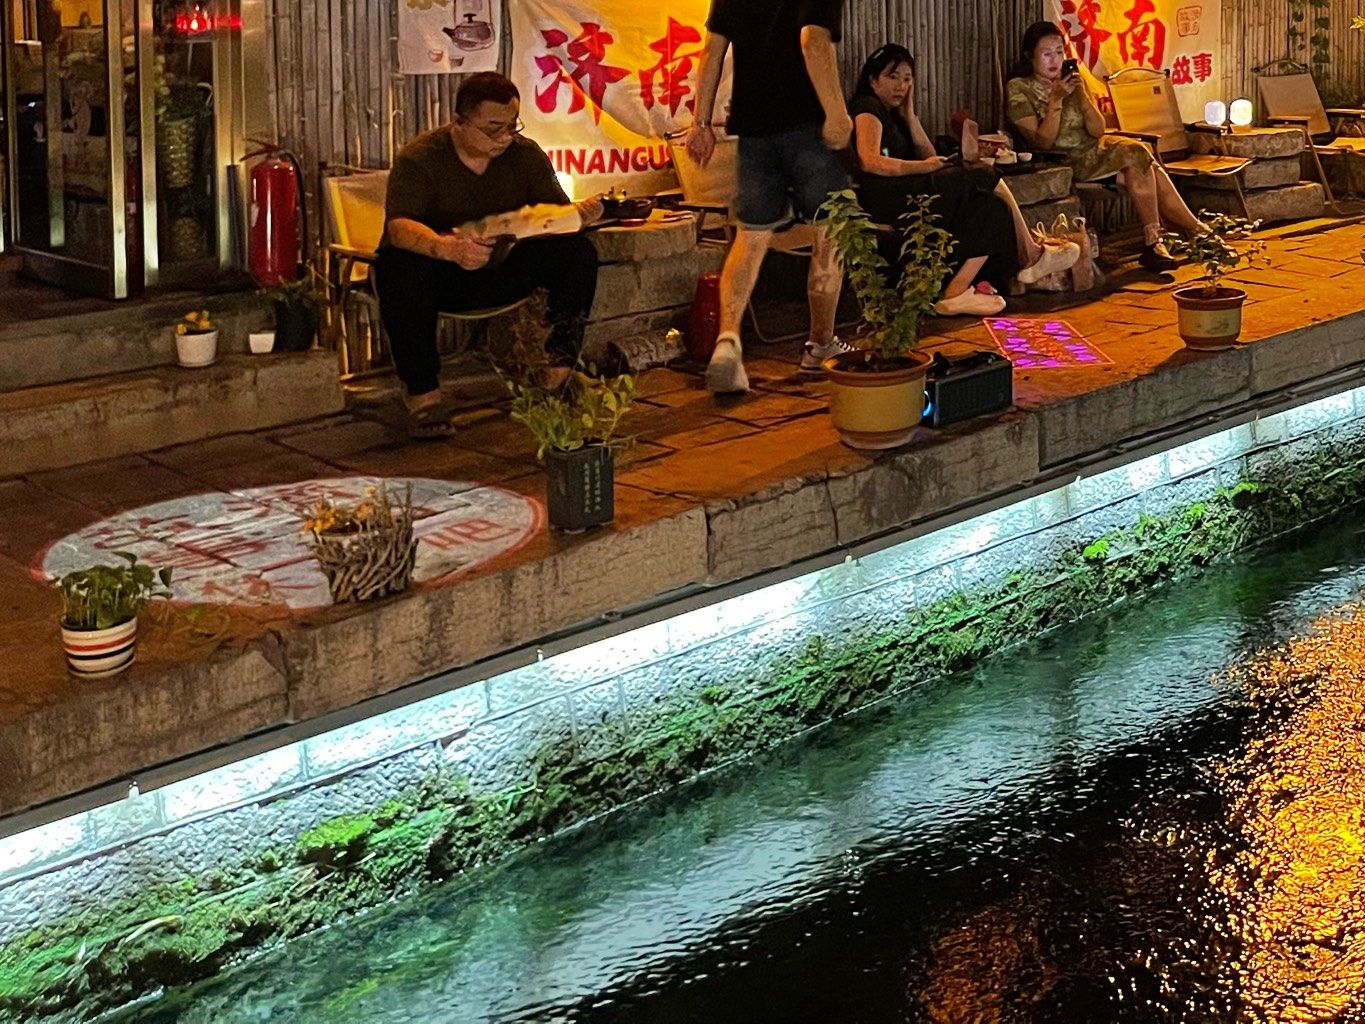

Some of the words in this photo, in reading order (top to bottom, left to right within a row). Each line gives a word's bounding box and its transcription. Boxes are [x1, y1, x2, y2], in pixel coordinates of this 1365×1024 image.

[534, 16, 705, 126] 济南
[1171, 52, 1213, 86] 故事
[548, 146, 672, 175] INANGU
